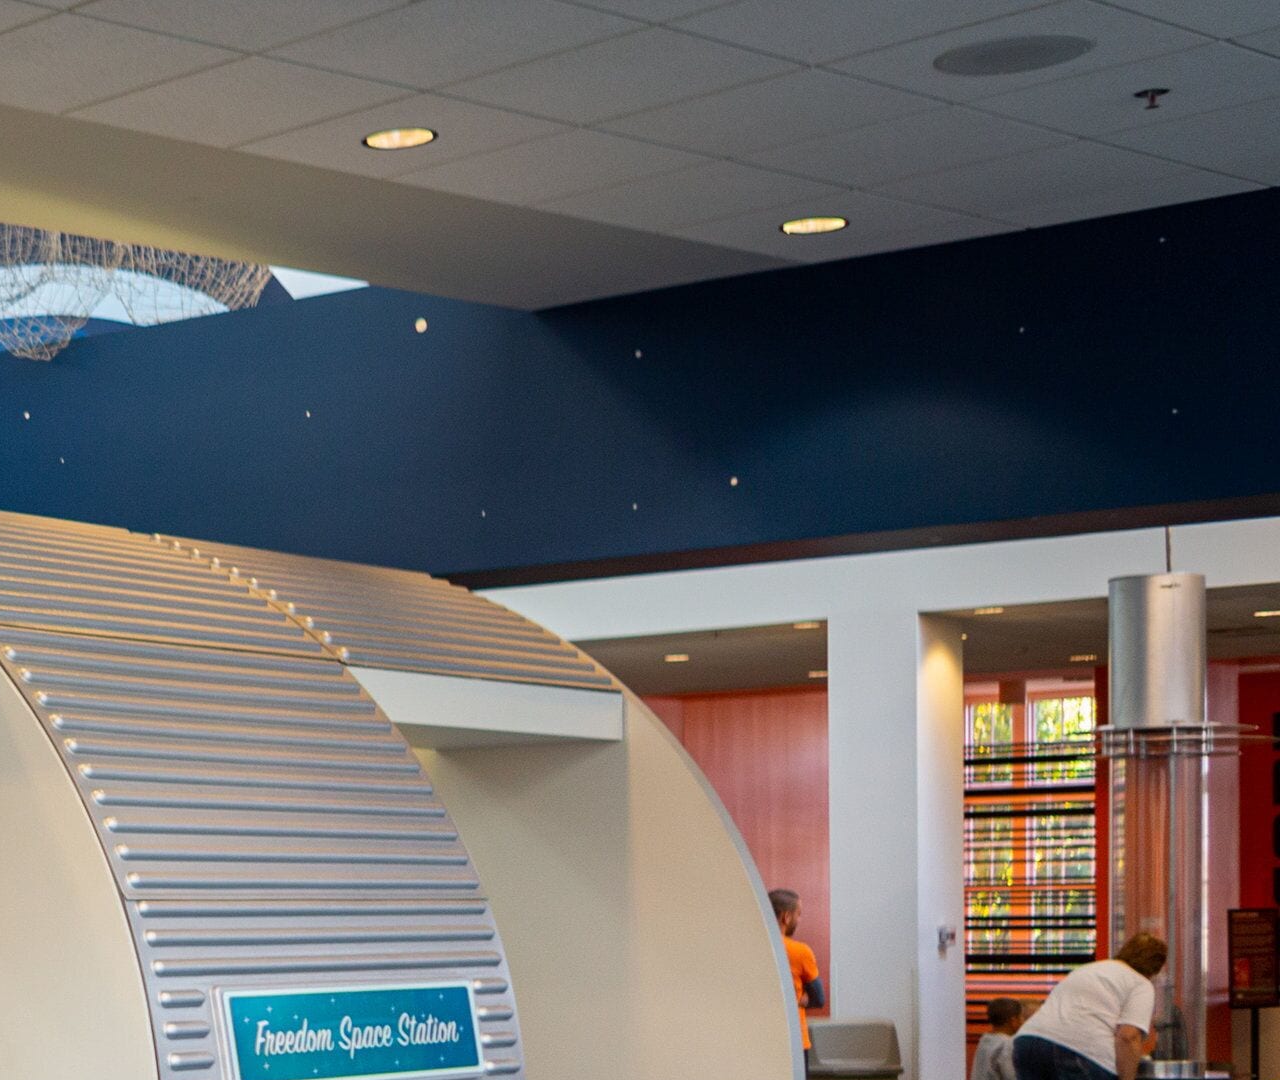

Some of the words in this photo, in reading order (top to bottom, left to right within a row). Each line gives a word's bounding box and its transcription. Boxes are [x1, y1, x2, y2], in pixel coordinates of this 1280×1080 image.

[255, 1018, 334, 1057] Freedom
[338, 1015, 393, 1060] Space
[397, 1012, 460, 1046] Station
